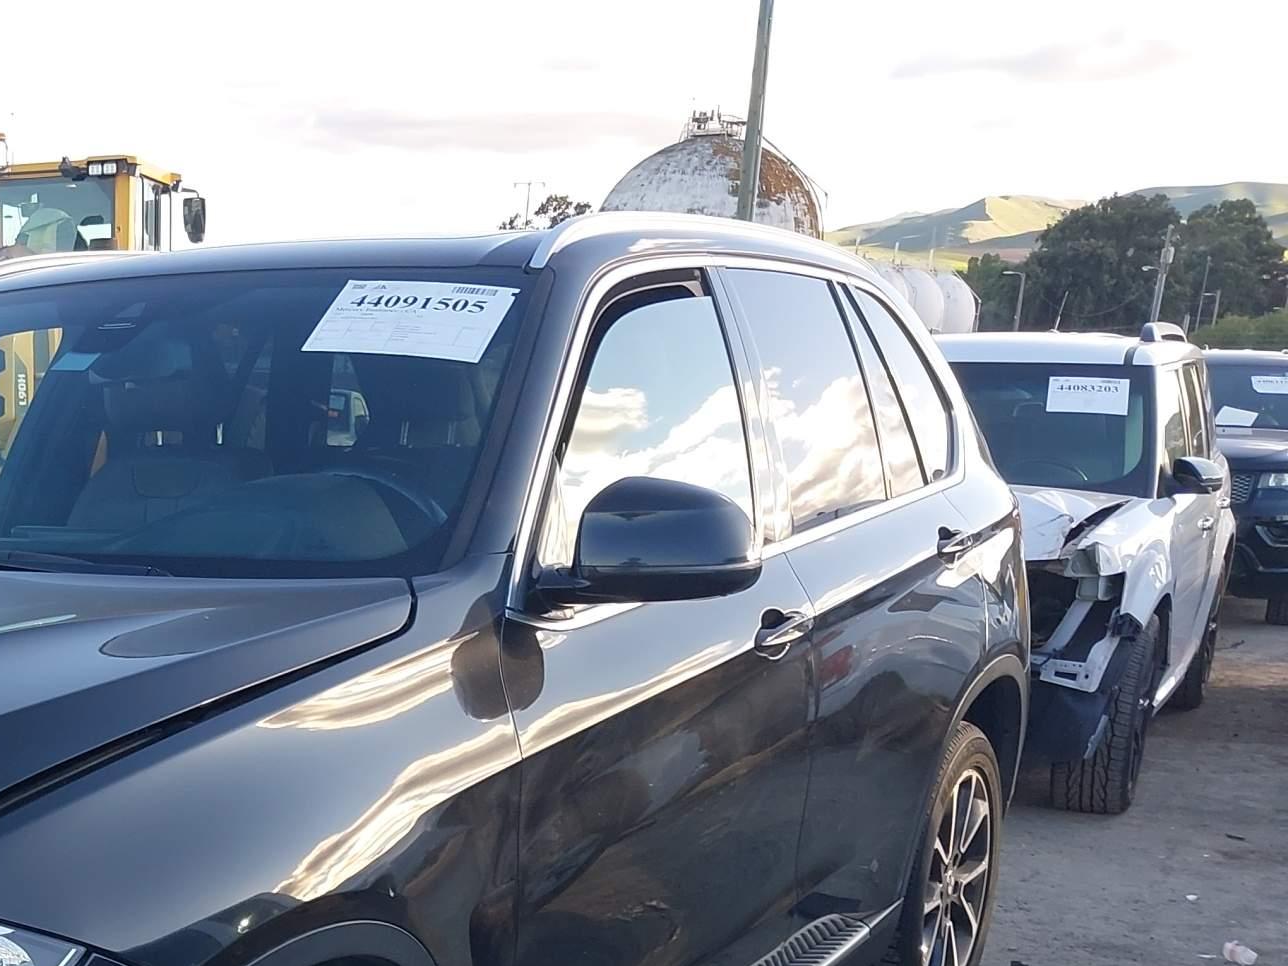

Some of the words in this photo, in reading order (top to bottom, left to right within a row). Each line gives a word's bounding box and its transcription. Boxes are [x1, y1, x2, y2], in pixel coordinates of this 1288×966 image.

[350, 294, 489, 314] 44091505
[17, 373, 28, 406] L90H
[1056, 384, 1120, 393] 44083203
